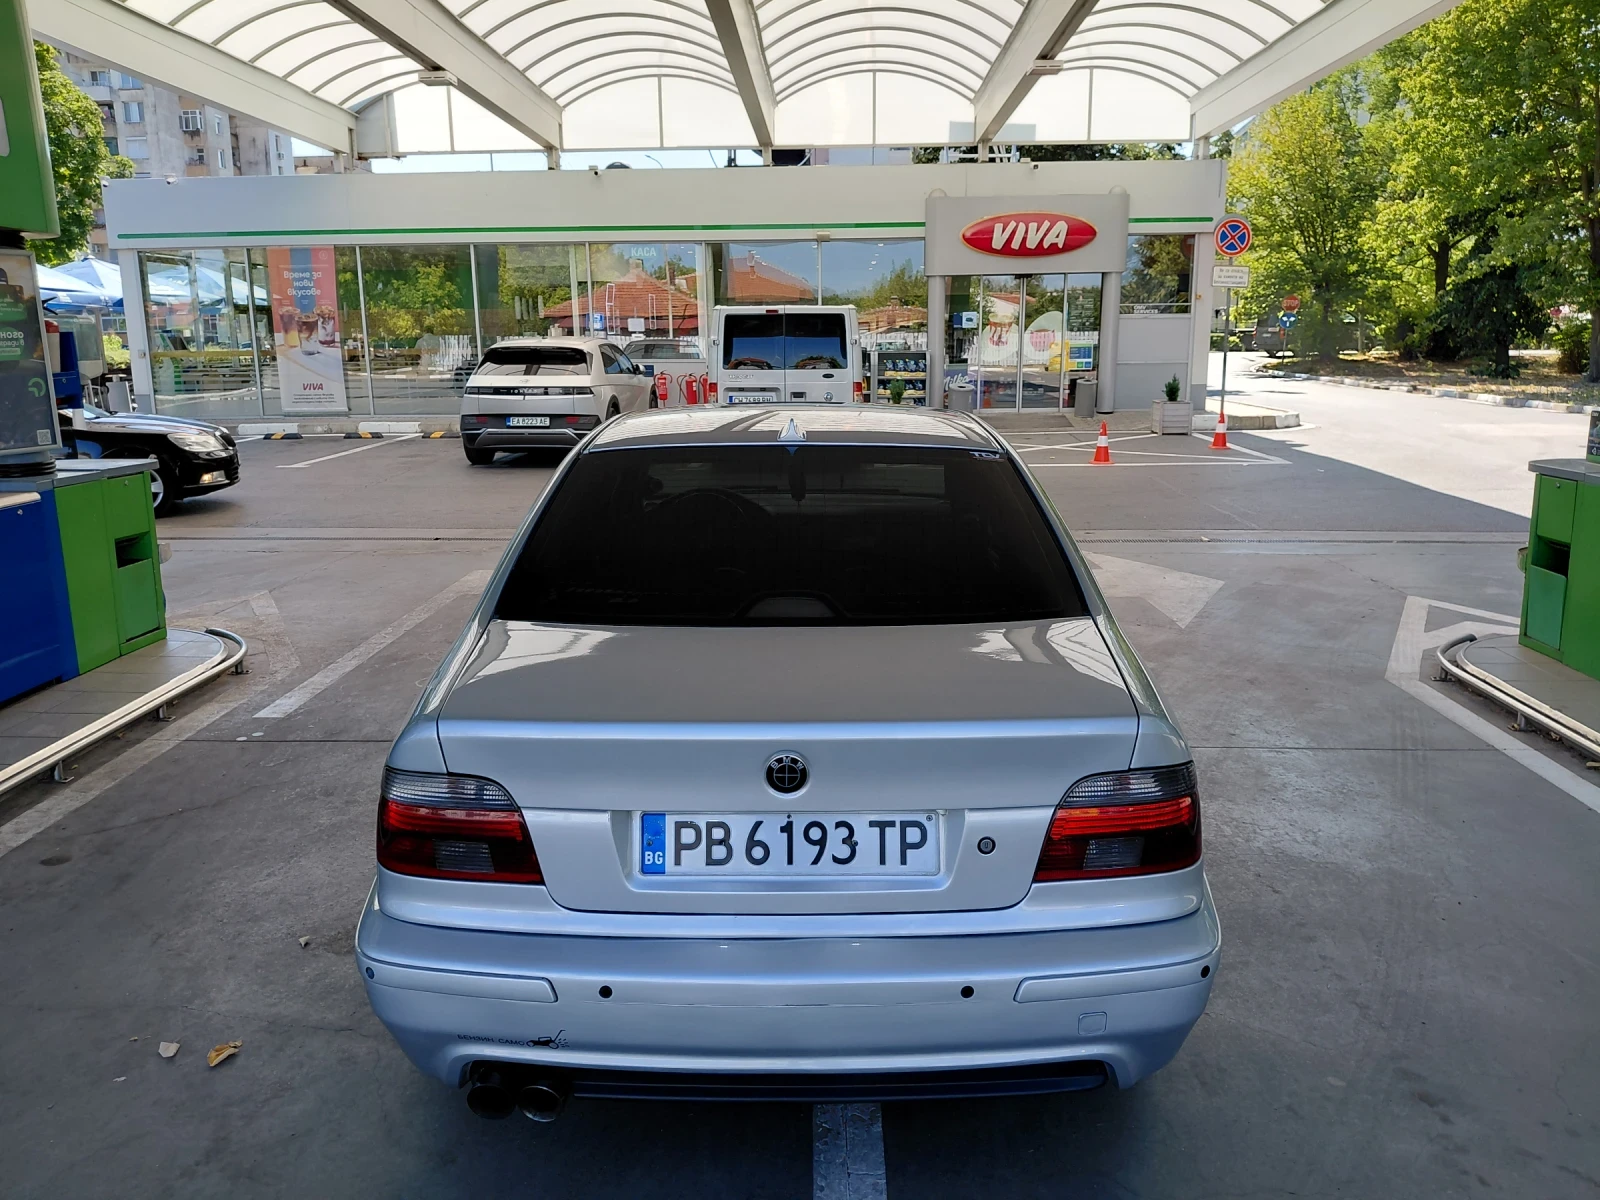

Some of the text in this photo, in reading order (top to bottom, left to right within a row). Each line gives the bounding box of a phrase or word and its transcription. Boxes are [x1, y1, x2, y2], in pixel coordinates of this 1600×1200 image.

[991, 219, 1068, 250] VIVA
[631, 247, 657, 257] КАСА
[283, 270, 322, 280] Време за
[293, 279, 314, 287] нови
[287, 287, 321, 297] вкусове
[1283, 299, 1298, 307] STOP
[302, 382, 324, 391] VIVA
[770, 756, 805, 770] BMW
[674, 820, 928, 866] PB 6193 TP
[644, 851, 664, 865] BG
[457, 1033, 525, 1046] БЕНЗИН САМО
